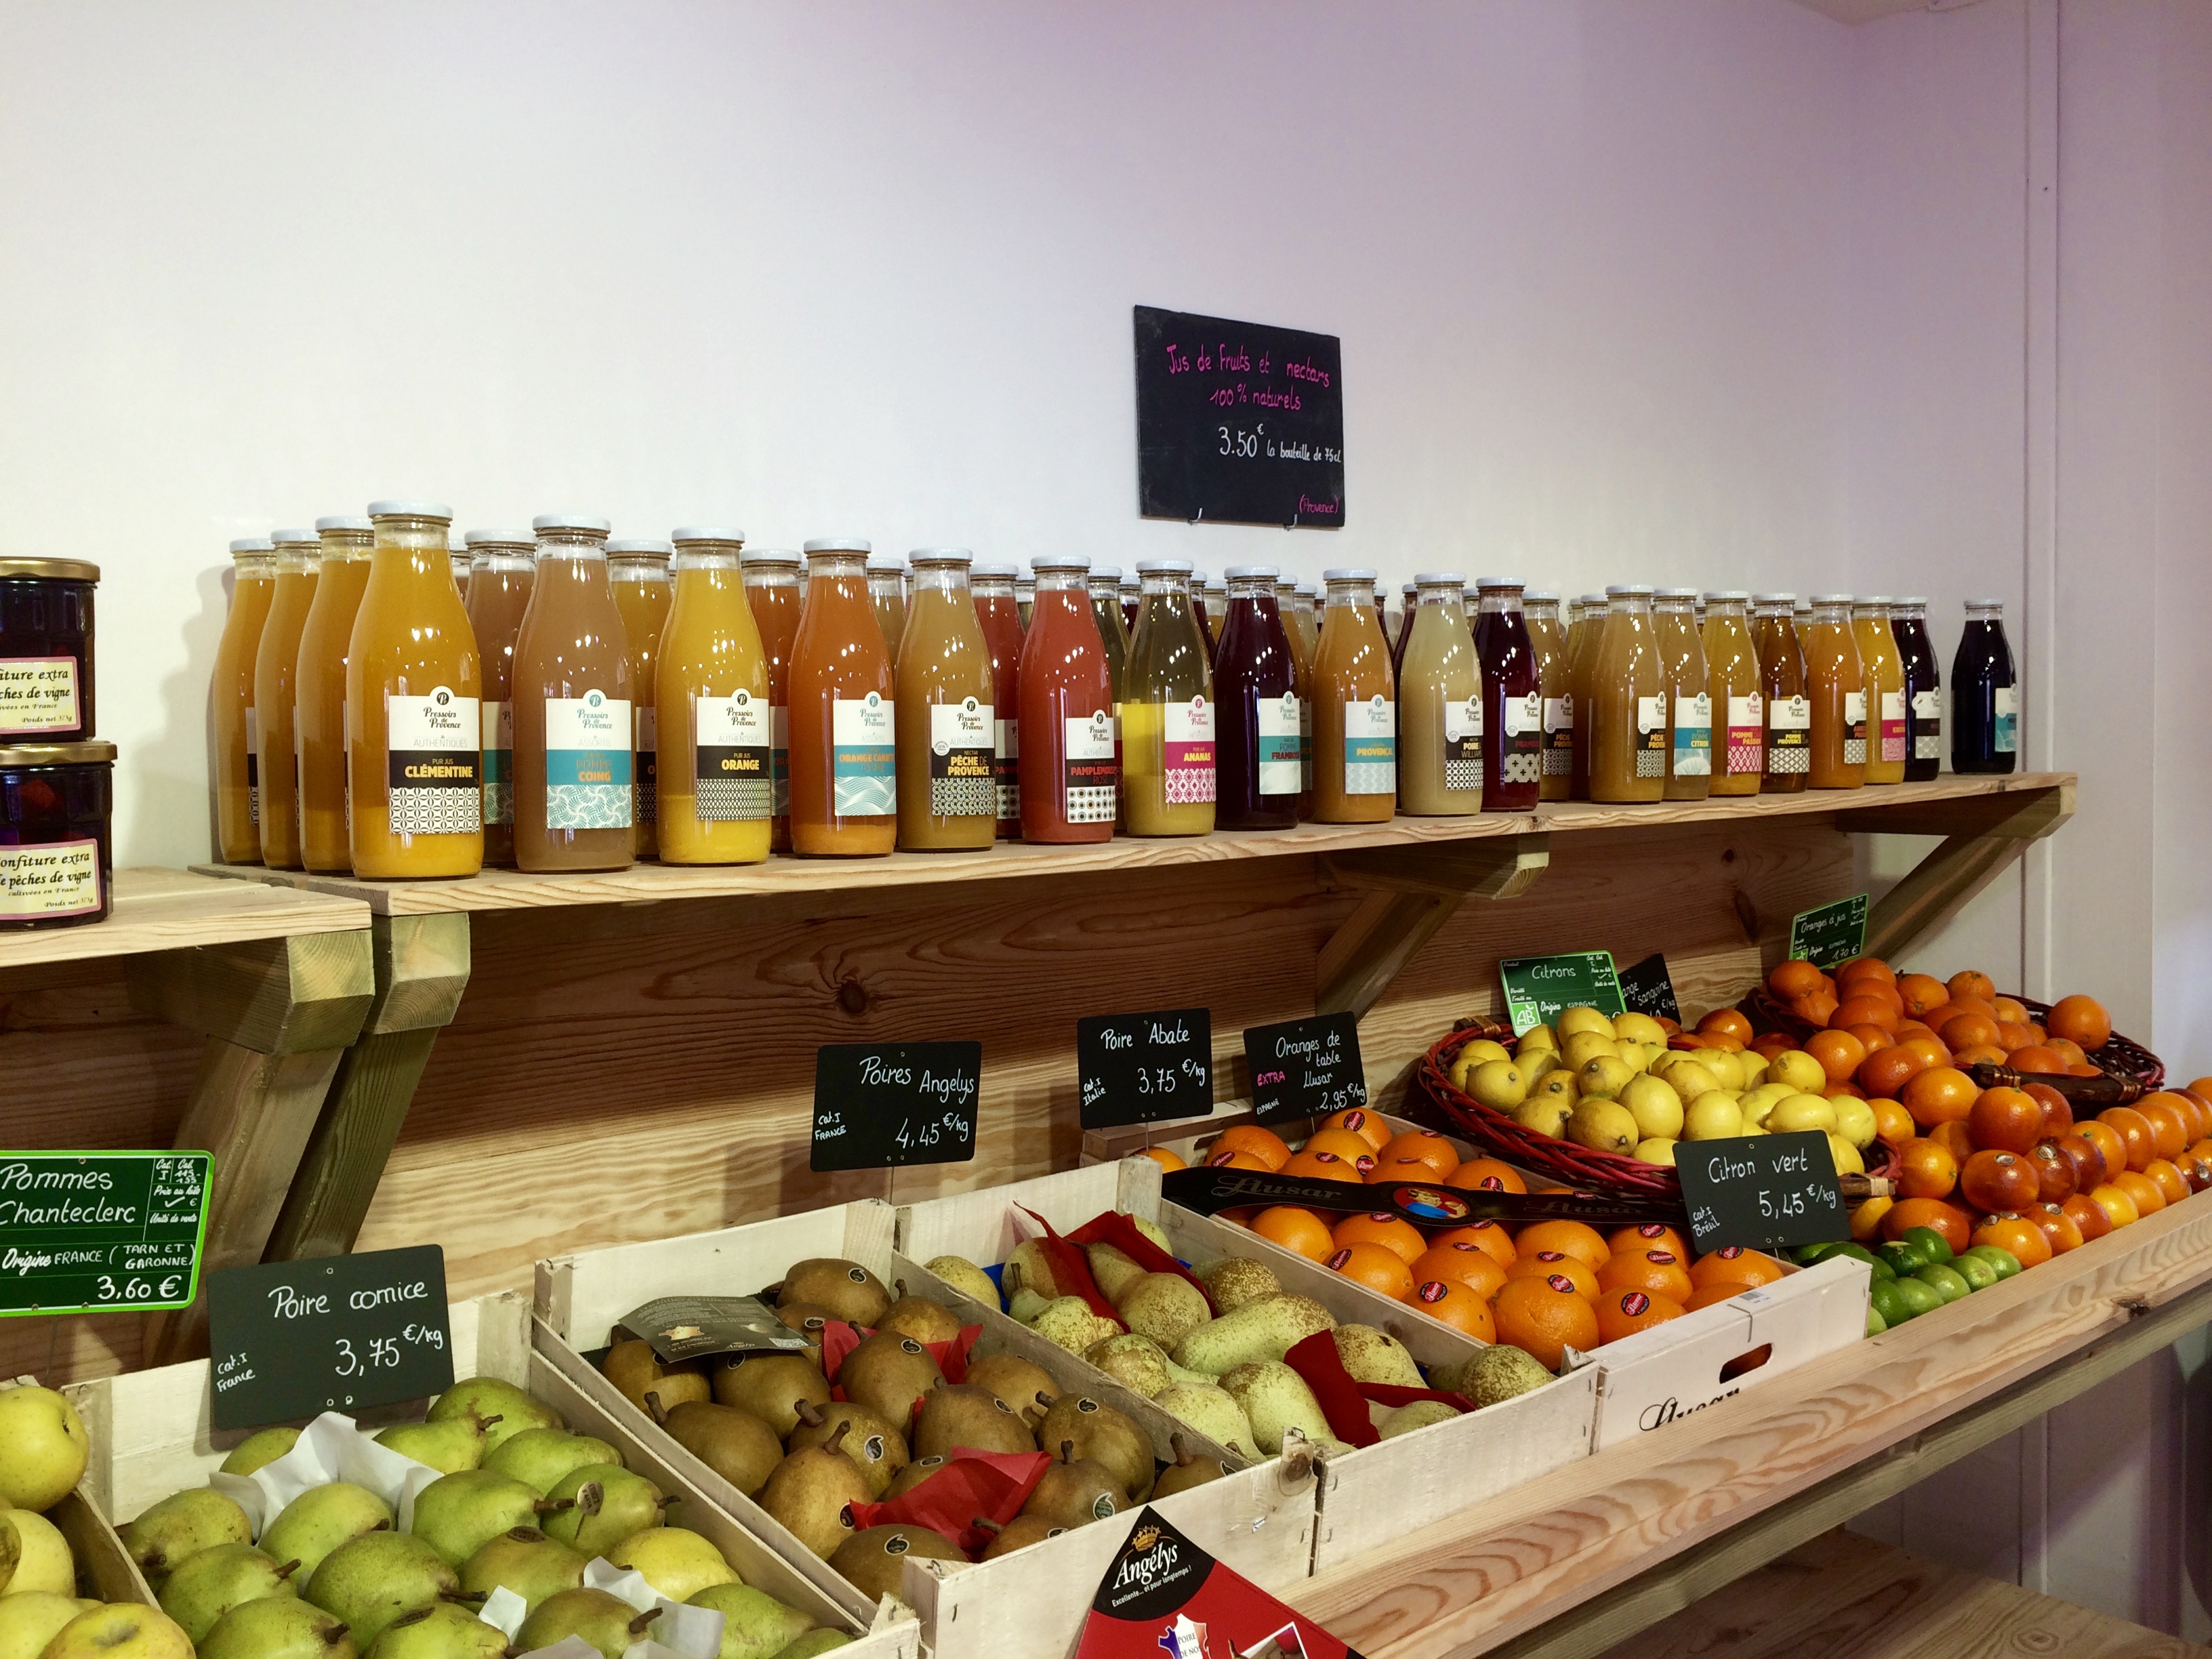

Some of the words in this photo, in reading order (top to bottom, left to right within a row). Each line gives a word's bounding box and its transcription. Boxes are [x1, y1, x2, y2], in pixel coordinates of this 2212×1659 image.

[1166, 344, 1189, 374] Jus
[1197, 343, 1212, 372] de
[1259, 350, 1270, 373] et
[1286, 356, 1330, 388] nectars
[1253, 386, 1301, 411] naturels
[1267, 439, 1275, 457] la
[1279, 441, 1311, 461] bouteille
[1313, 447, 1322, 462] de
[1298, 494, 1339, 514] (Provence)
[39, 670, 68, 681] extra
[26, 687, 41, 698] de
[44, 687, 70, 701] vigne
[424, 707, 456, 718] Pressoirs
[577, 708, 608, 718] Pressoirs
[726, 707, 753, 716] Pressoirs
[430, 718, 461, 728] Provence
[582, 719, 613, 729] Provence
[731, 716, 756, 726] Provence
[413, 739, 468, 747] AUTHENTIQUES
[718, 735, 761, 743] AUTHENTIQUES
[1463, 742, 1479, 750] POIRE
[721, 759, 760, 771] ORANGE
[839, 754, 872, 763] ORANGE
[950, 754, 979, 766] PÊCHE
[979, 756, 987, 766] DE
[1183, 752, 1211, 762] ANANAS
[405, 764, 473, 778] CLÉMENTINE
[578, 771, 612, 782] COING
[947, 766, 989, 776] PROVENCE
[0, 855, 57, 872] onfiture
[61, 853, 89, 865] extra
[8, 872, 47, 890] pêches
[49, 871, 64, 883] de
[66, 869, 91, 884] vigne
[1801, 919, 1827, 933] Oranges
[1835, 913, 1846, 926] jus
[1851, 944, 1860, 954] €
[1532, 964, 1576, 980] Citrons
[1637, 981, 1670, 1006] sanguine
[1517, 1010, 1536, 1025] AB
[1101, 1029, 1133, 1050] Poire
[1149, 1019, 1190, 1044] Abate
[1275, 1036, 1320, 1063] Oranges
[1327, 1030, 1340, 1048] de
[1316, 1050, 1341, 1067] table
[859, 1056, 912, 1085] Poires
[919, 1068, 975, 1105] Angelys
[1256, 1071, 1286, 1087] EXTRA
[1083, 1086, 1106, 1106] Italie
[1256, 1098, 1279, 1115] ESPAGNE
[815, 1125, 846, 1141] FRANCE
[1708, 1156, 1756, 1183] Citron
[1772, 1147, 1809, 1174] vert
[0, 1162, 113, 1190] Pommes
[158, 1170, 169, 1180] I
[1211, 1176, 1341, 1201] Llusar
[190, 1197, 198, 1206] €
[1692, 1214, 1721, 1237] Brésil
[2, 1248, 52, 1276] Origine
[54, 1250, 103, 1265] FRANCE
[123, 1244, 159, 1254] TARN
[165, 1244, 185, 1252] ET
[125, 1256, 188, 1269] GARONNE
[97, 1275, 151, 1300] 3,60
[159, 1275, 182, 1298] €
[268, 1285, 331, 1319] Poire
[350, 1282, 428, 1310] comice
[216, 1368, 255, 1393] France
[1112, 1541, 1178, 1590] Angélys
[1150, 1579, 1162, 1591] pour
[1162, 1568, 1189, 1584] longtemps
[1177, 1633, 1197, 1645] POIRE
